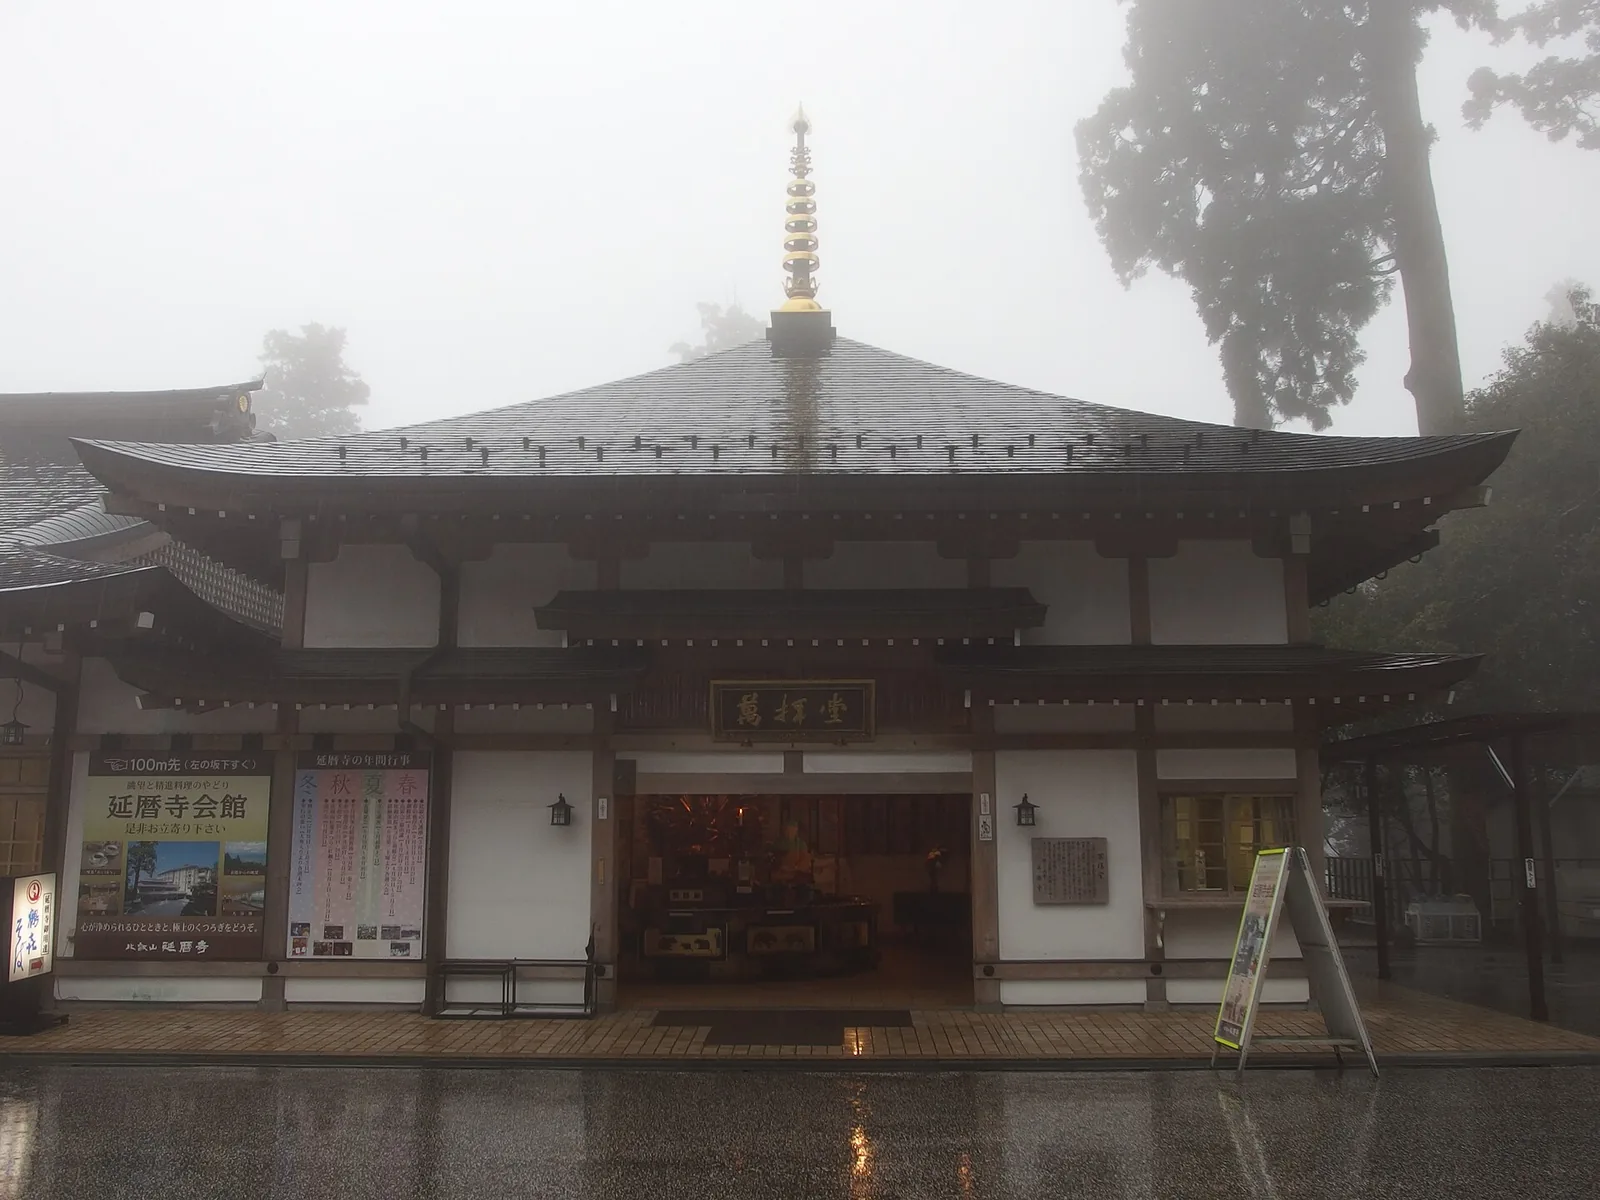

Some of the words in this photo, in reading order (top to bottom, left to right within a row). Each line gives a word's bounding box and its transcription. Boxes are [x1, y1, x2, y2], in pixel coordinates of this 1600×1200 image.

[130, 758, 181, 772] 100m先
[316, 754, 411, 766] 延暦寺の年間行事
[299, 775, 318, 795] 冬
[330, 774, 351, 795] 秋
[363, 774, 385, 795] 夏
[397, 773, 418, 795] 春
[106, 794, 248, 819] 延暦寺会館
[125, 823, 227, 836] 是非お立寄り下さい
[161, 939, 210, 955] 延暦寺
